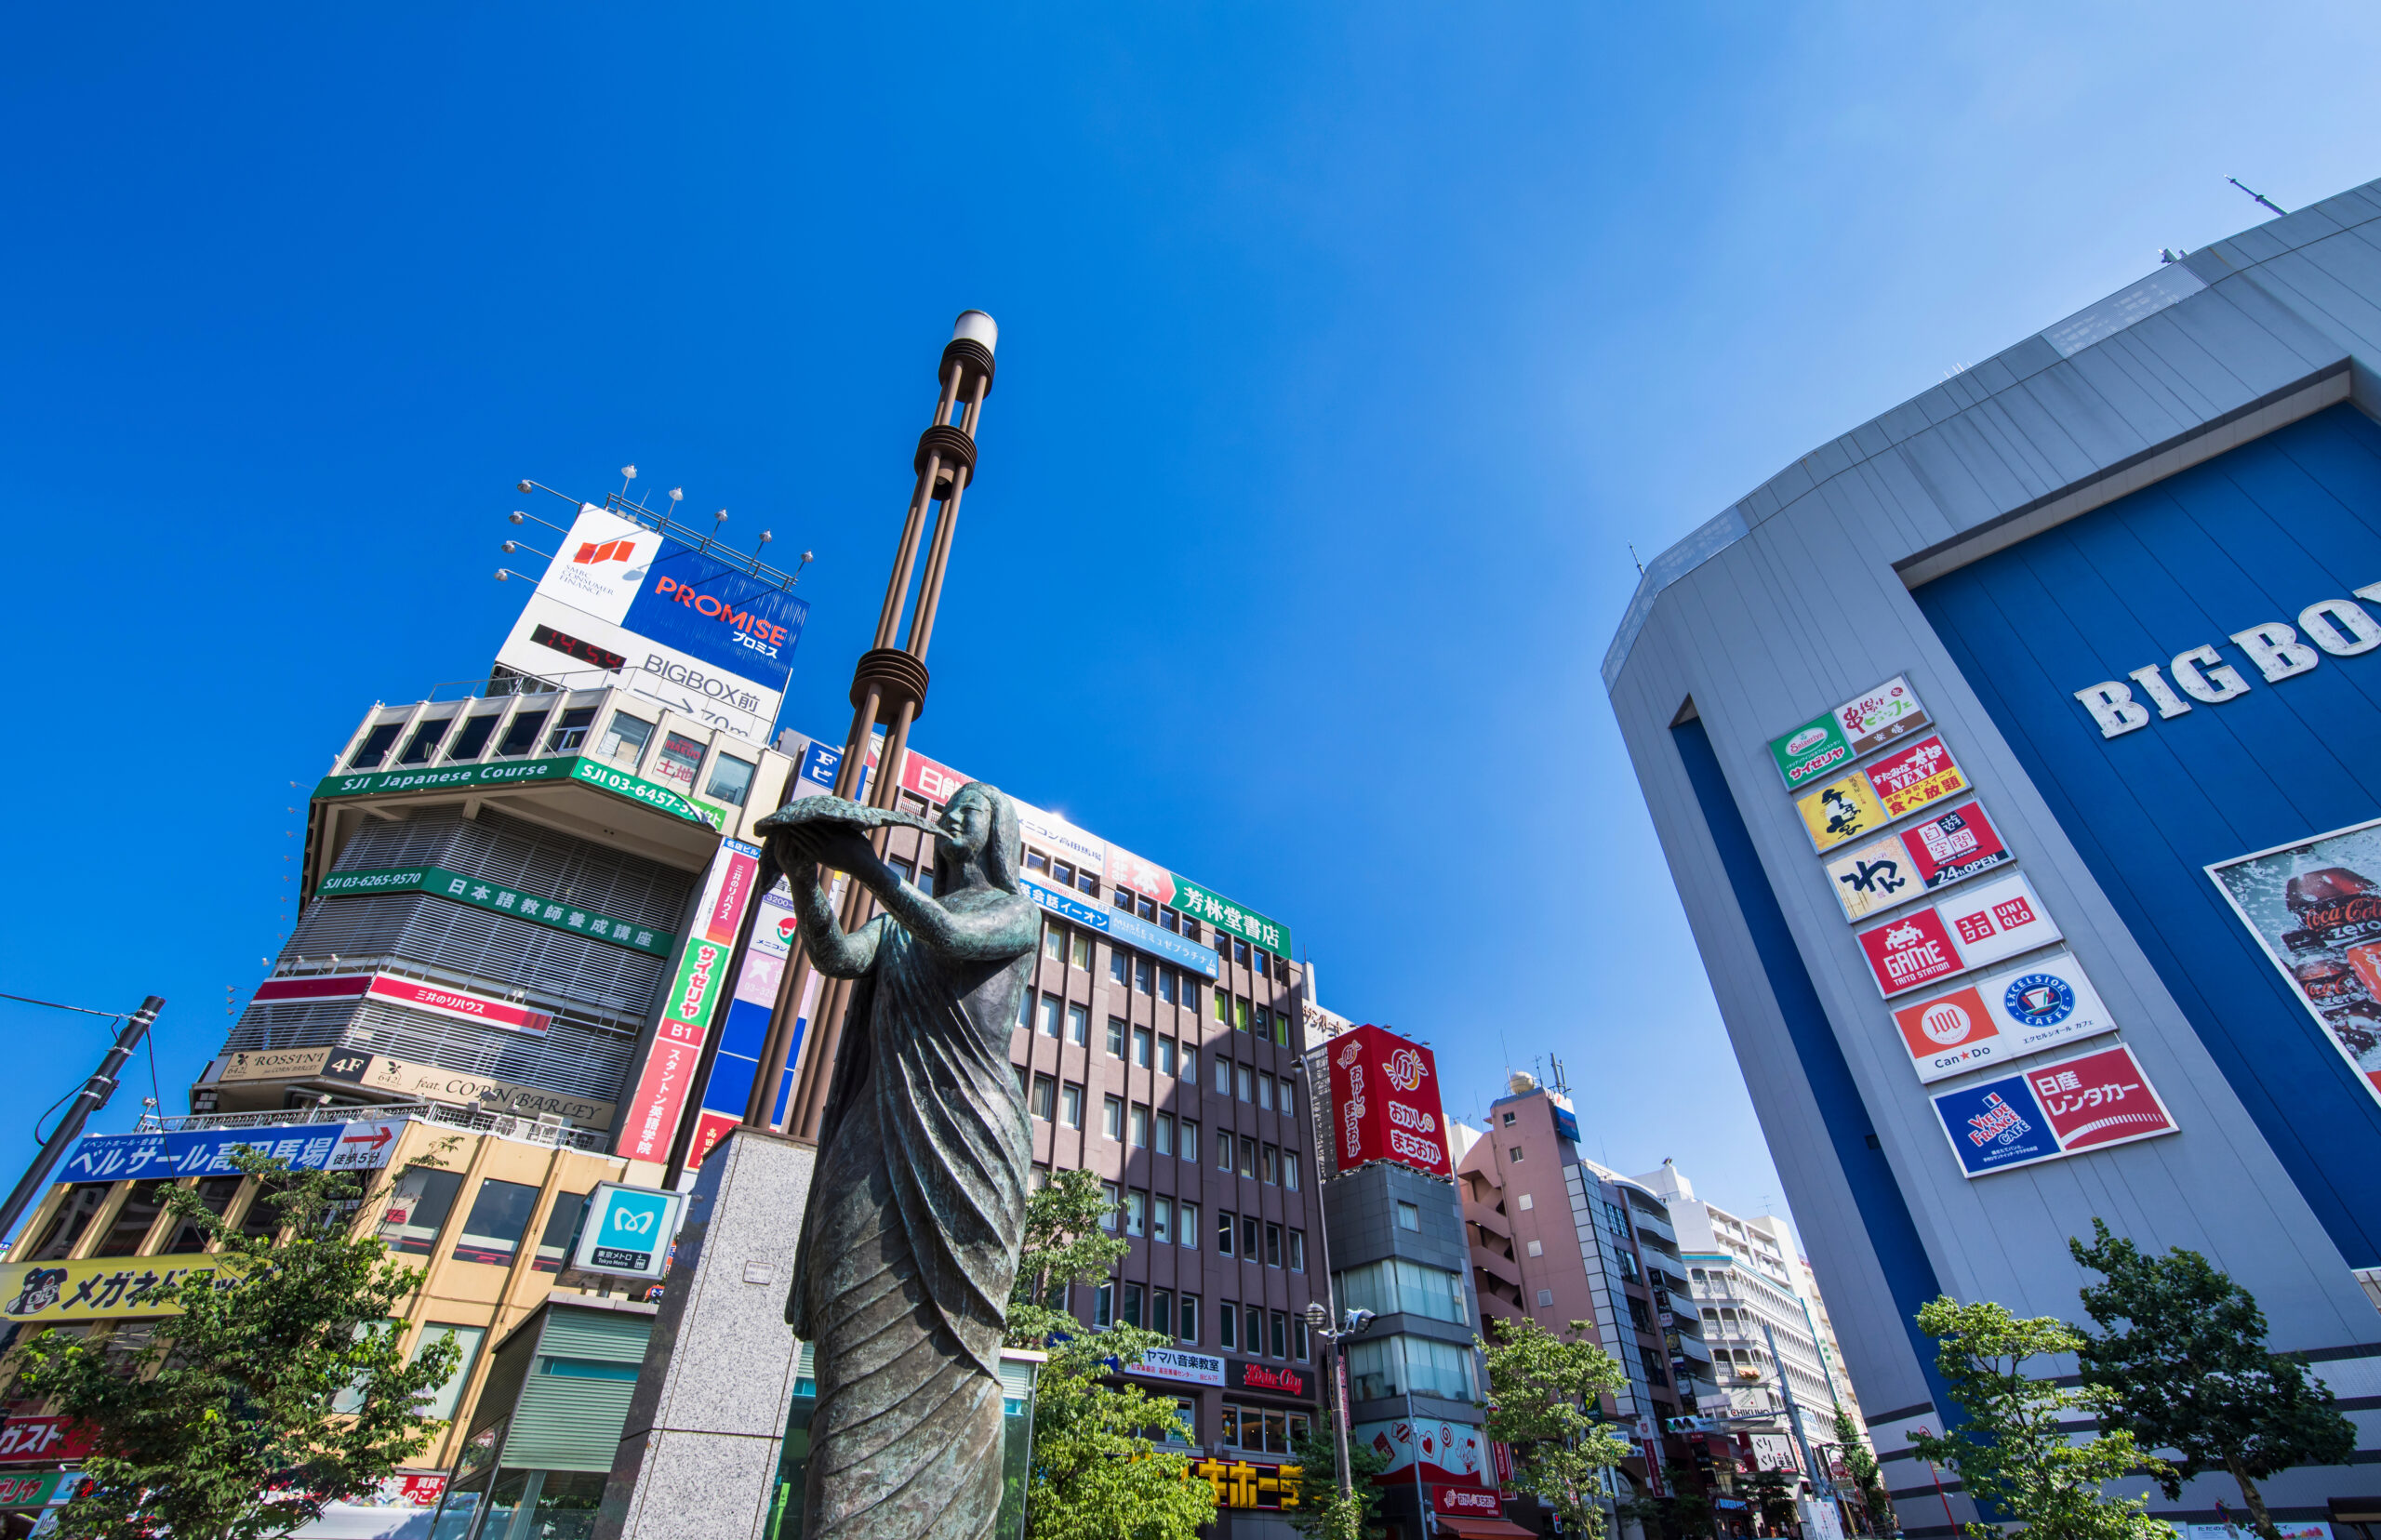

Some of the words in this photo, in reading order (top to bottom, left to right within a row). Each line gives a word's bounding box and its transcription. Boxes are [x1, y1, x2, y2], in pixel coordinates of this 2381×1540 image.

[559, 575, 600, 595] FINANCE
[562, 570, 614, 595] CONSUMER
[566, 564, 589, 578] SMBC
[655, 576, 788, 646] PROMISE
[732, 631, 778, 659] プロミス
[2073, 580, 2381, 738] BIGBO
[643, 654, 761, 713] BIGBOX前
[1843, 697, 1884, 734] 串揚げ
[1865, 699, 1912, 726] ビュッフェ
[1789, 732, 1826, 753] Saizeriya
[340, 777, 371, 790] SJI
[379, 770, 472, 789] Japanese
[480, 763, 548, 779] Course
[580, 764, 607, 783] SJI
[657, 760, 693, 783] 土地
[1789, 747, 1845, 780] サイゼリヤ
[1889, 760, 1938, 793] NEXT
[1889, 776, 1962, 816] 食べ放題
[726, 840, 758, 856] 名店ビル
[324, 877, 342, 890] SJI
[342, 873, 421, 888] 03-6265-9570
[1132, 861, 1160, 896] 本
[1840, 859, 1906, 894] わん
[719, 864, 744, 921] 三井のリハウス
[1019, 882, 1107, 927] 英会話イーオン
[447, 878, 654, 948] 日本語教師養成講座
[1182, 886, 1280, 949] 芳林堂書店
[1997, 900, 2024, 918] UNI
[2002, 910, 2030, 927] QLO
[756, 939, 789, 952] メニコン
[1149, 936, 1217, 968] ミュゼプラチナム
[1883, 940, 1947, 979] GAME
[679, 945, 719, 1021] サイゼリヤ
[1894, 973, 1916, 988] TAITO
[1919, 962, 1950, 979] STATION
[415, 990, 485, 1015] 三井のリハウス
[2006, 975, 2068, 1008] EXCELSIOR
[1927, 1008, 1962, 1036] 100
[2024, 1003, 2071, 1026] CAFFE
[671, 1024, 692, 1040] B1
[2023, 1026, 2072, 1044] エクセルシオール
[2075, 1019, 2095, 1029] カフェ
[254, 1052, 326, 1067] ROSSINI
[331, 1058, 365, 1073] 4F
[1350, 1064, 1366, 1119] おかしの
[2036, 1069, 2082, 1097] 日産
[411, 1077, 441, 1091] feat.
[513, 1092, 603, 1121] BARLEY
[636, 1049, 681, 1155] スタントン英語学院
[2046, 1082, 2139, 1116] レンタカー
[1344, 1100, 1362, 1158] まちおか
[1389, 1101, 1435, 1133] おかしの
[1968, 1110, 2021, 1147] FRANCE
[1390, 1130, 1442, 1164] まちおか
[597, 1250, 632, 1262] 東京メトロ
[1146, 1349, 1219, 1372] ヤマハ音楽教室
[1159, 1367, 1193, 1377] 高田馬場センター
